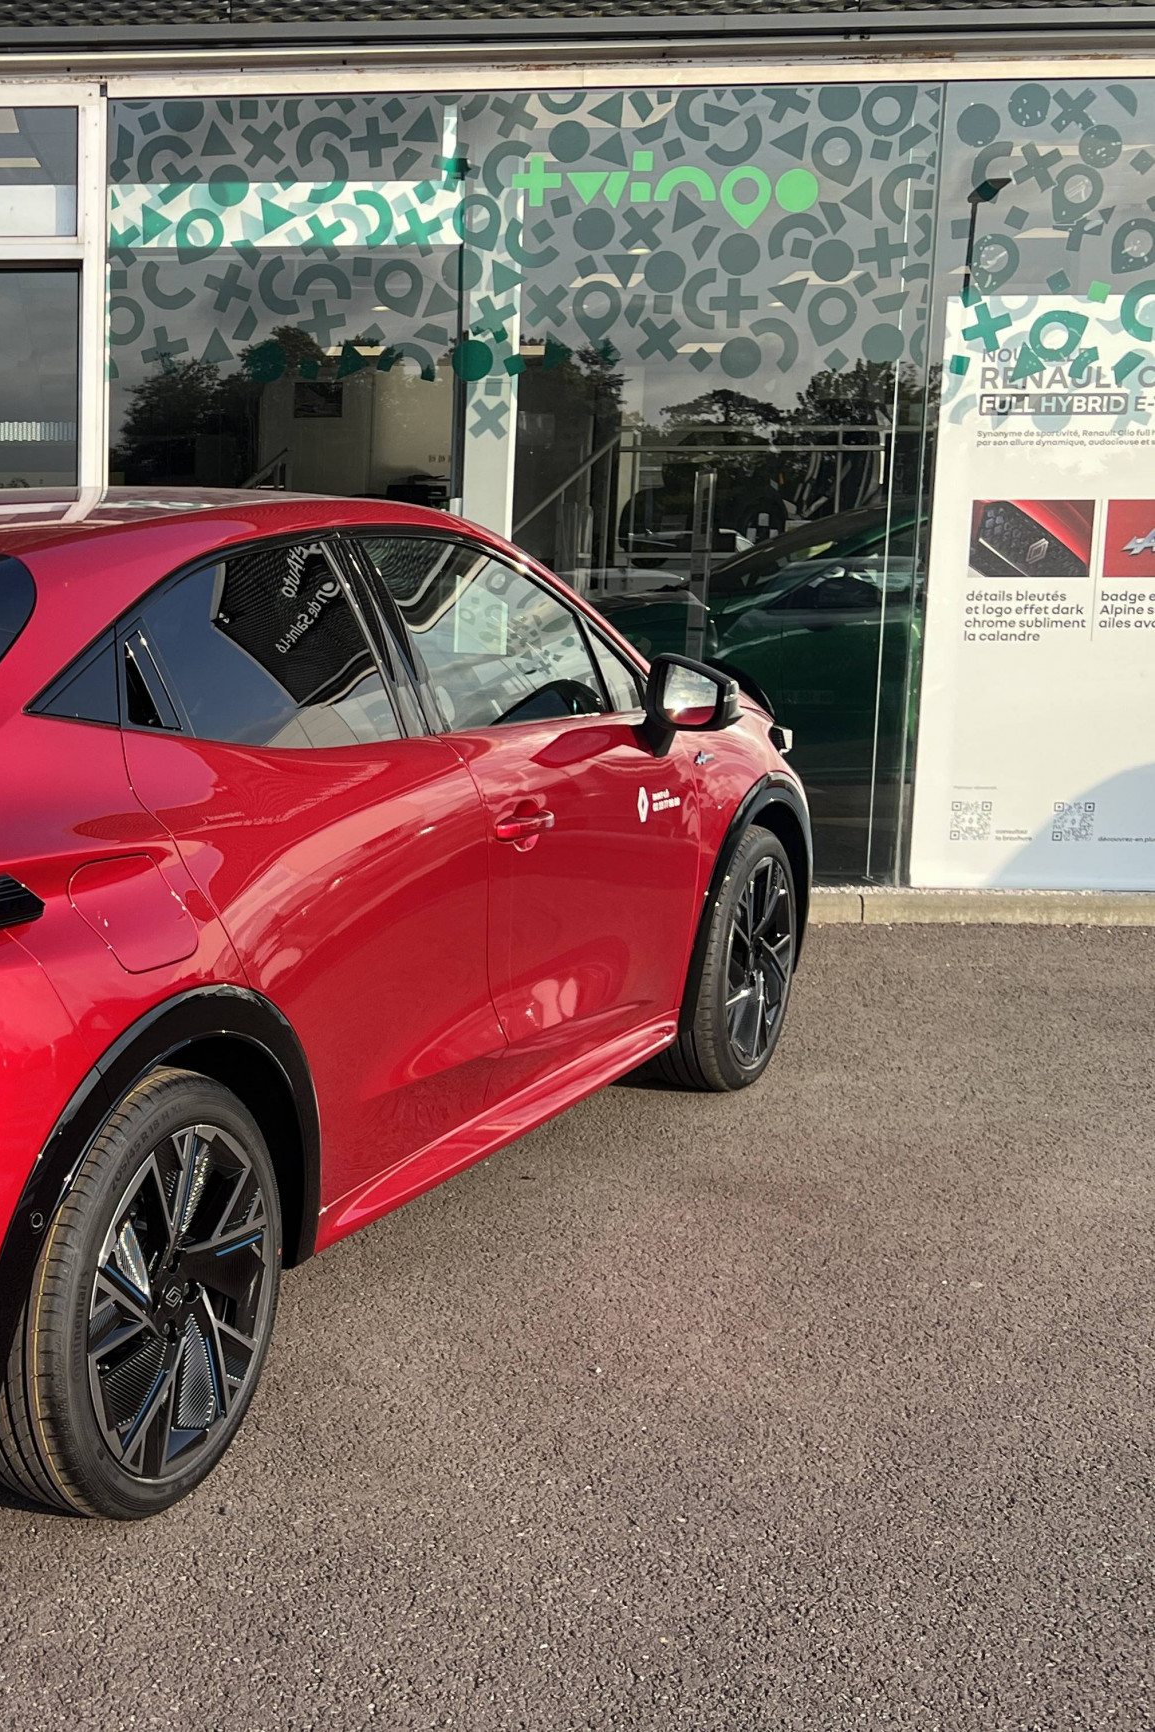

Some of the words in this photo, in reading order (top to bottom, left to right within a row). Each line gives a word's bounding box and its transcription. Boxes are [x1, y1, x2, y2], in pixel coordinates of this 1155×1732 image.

[981, 396, 1036, 413] FULL
[1040, 396, 1126, 413] HYBRID
[977, 430, 1023, 439] Synonyme
[966, 590, 1013, 602] détails
[1016, 590, 1067, 602] bleutés
[1101, 591, 1146, 604] badge
[965, 605, 979, 615] et
[982, 604, 1012, 617] logo
[1015, 604, 1049, 615] effet
[1051, 604, 1084, 615] dark
[1099, 604, 1145, 617] Alpine
[964, 618, 1016, 628] chrome
[1018, 618, 1086, 628] subliment
[1098, 618, 1131, 628] ailes
[963, 631, 976, 642] la
[979, 631, 1041, 642] calandre
